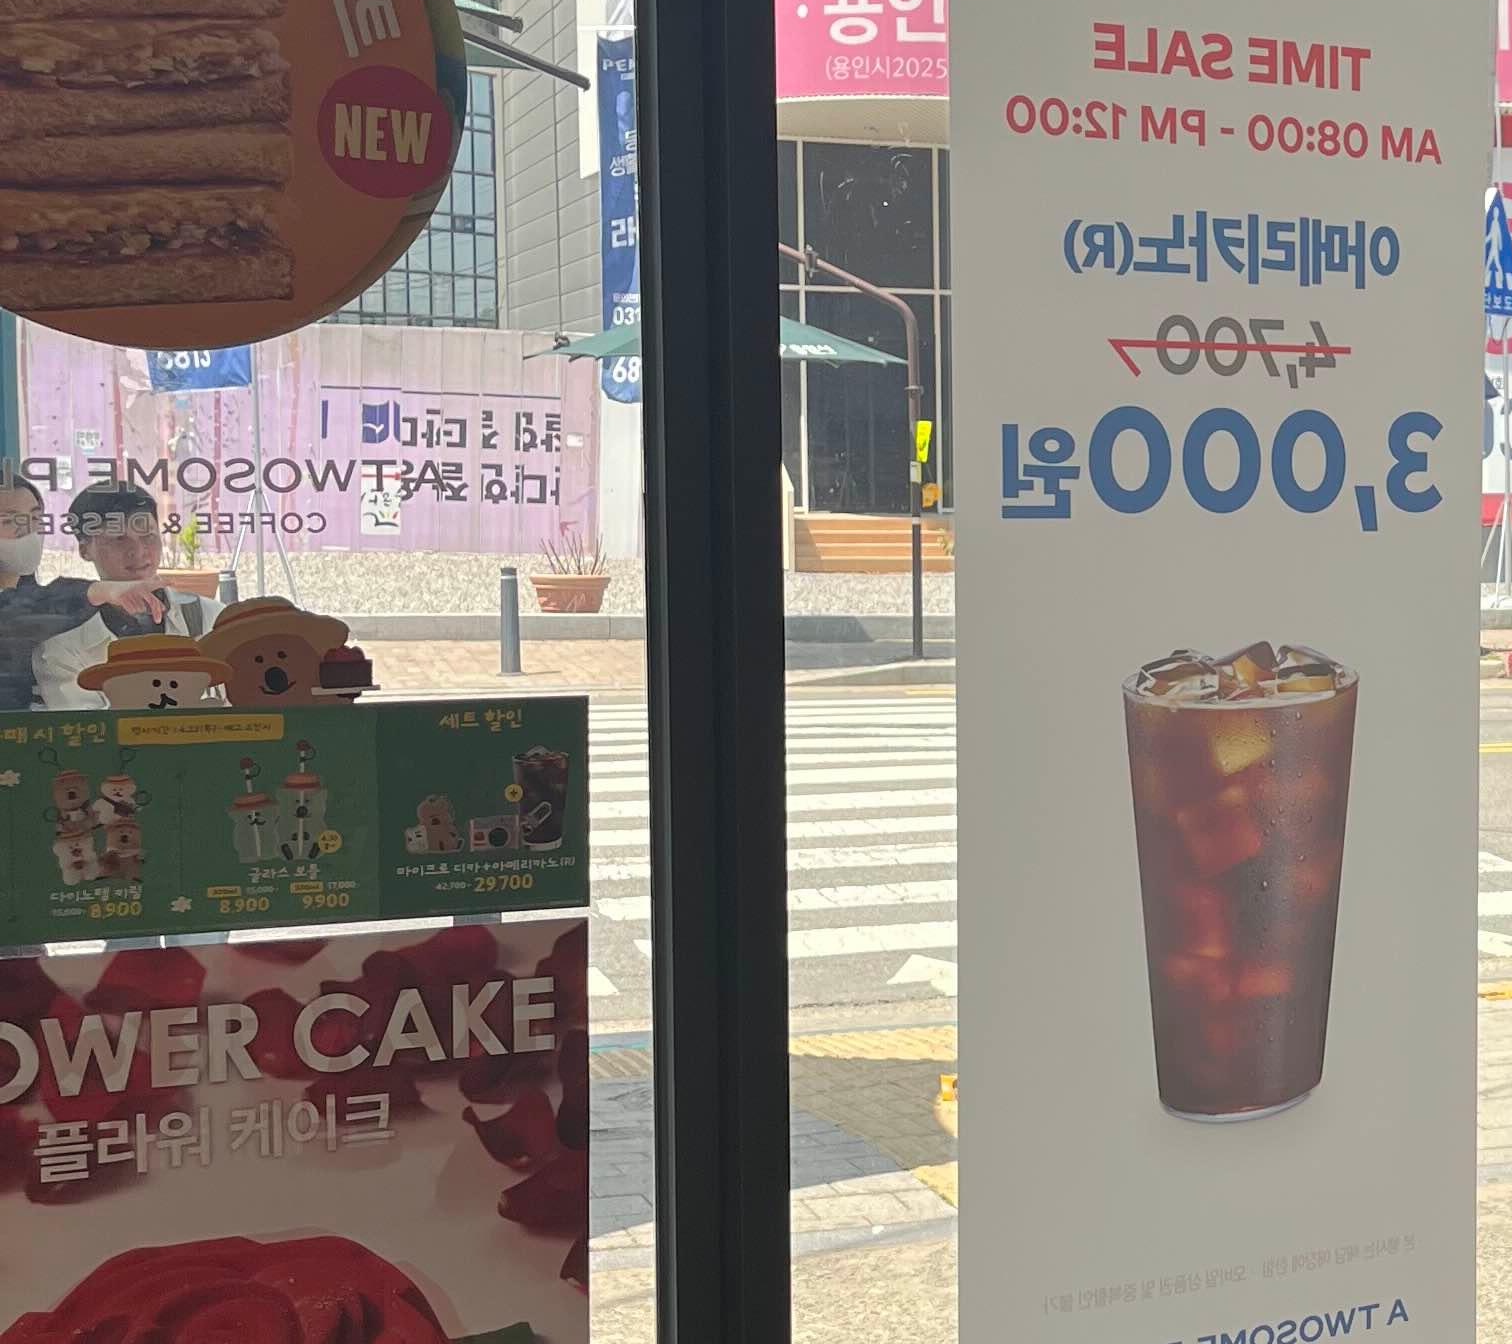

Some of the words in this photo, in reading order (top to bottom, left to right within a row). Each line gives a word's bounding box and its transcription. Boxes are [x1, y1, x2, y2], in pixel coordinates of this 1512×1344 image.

[334, 103, 432, 164] NEW
[60, 722, 106, 747] 할인
[439, 710, 480, 730] 세트
[484, 709, 522, 732] 할인
[294, 976, 557, 1074] CAKE
[34, 1105, 210, 1184] 플라워
[230, 1092, 396, 1158] 케이크
